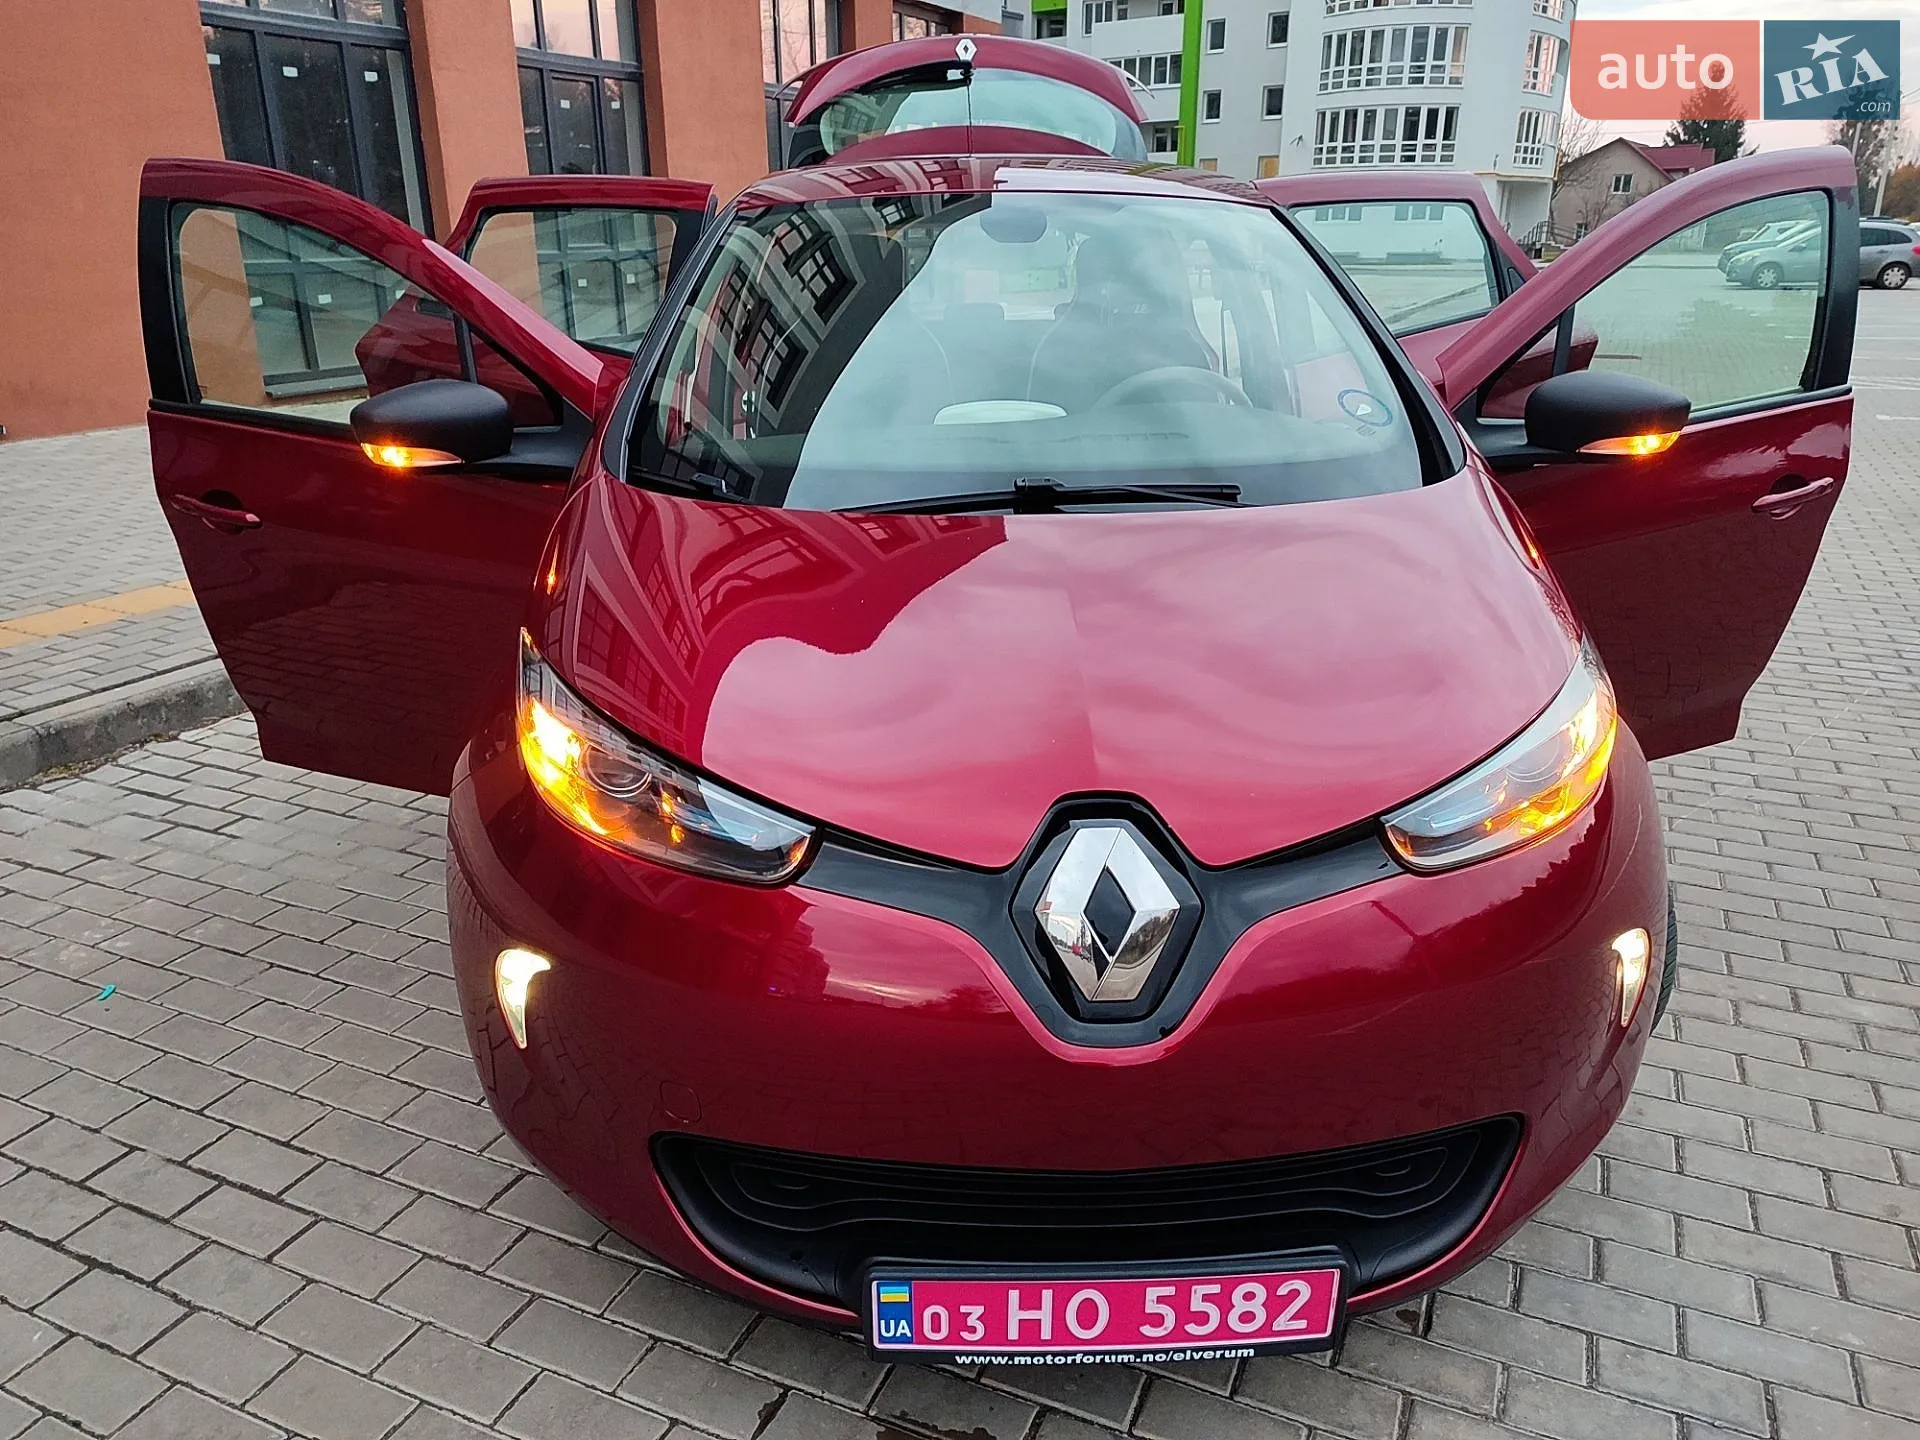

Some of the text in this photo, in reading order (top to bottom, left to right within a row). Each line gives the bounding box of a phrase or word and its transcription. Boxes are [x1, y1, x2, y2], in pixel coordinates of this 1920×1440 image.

[922, 1279, 1312, 1341] 03 HO 5582
[880, 1319, 912, 1338] UA
[954, 1348, 1255, 1366] www.motorforum.no/elverum
